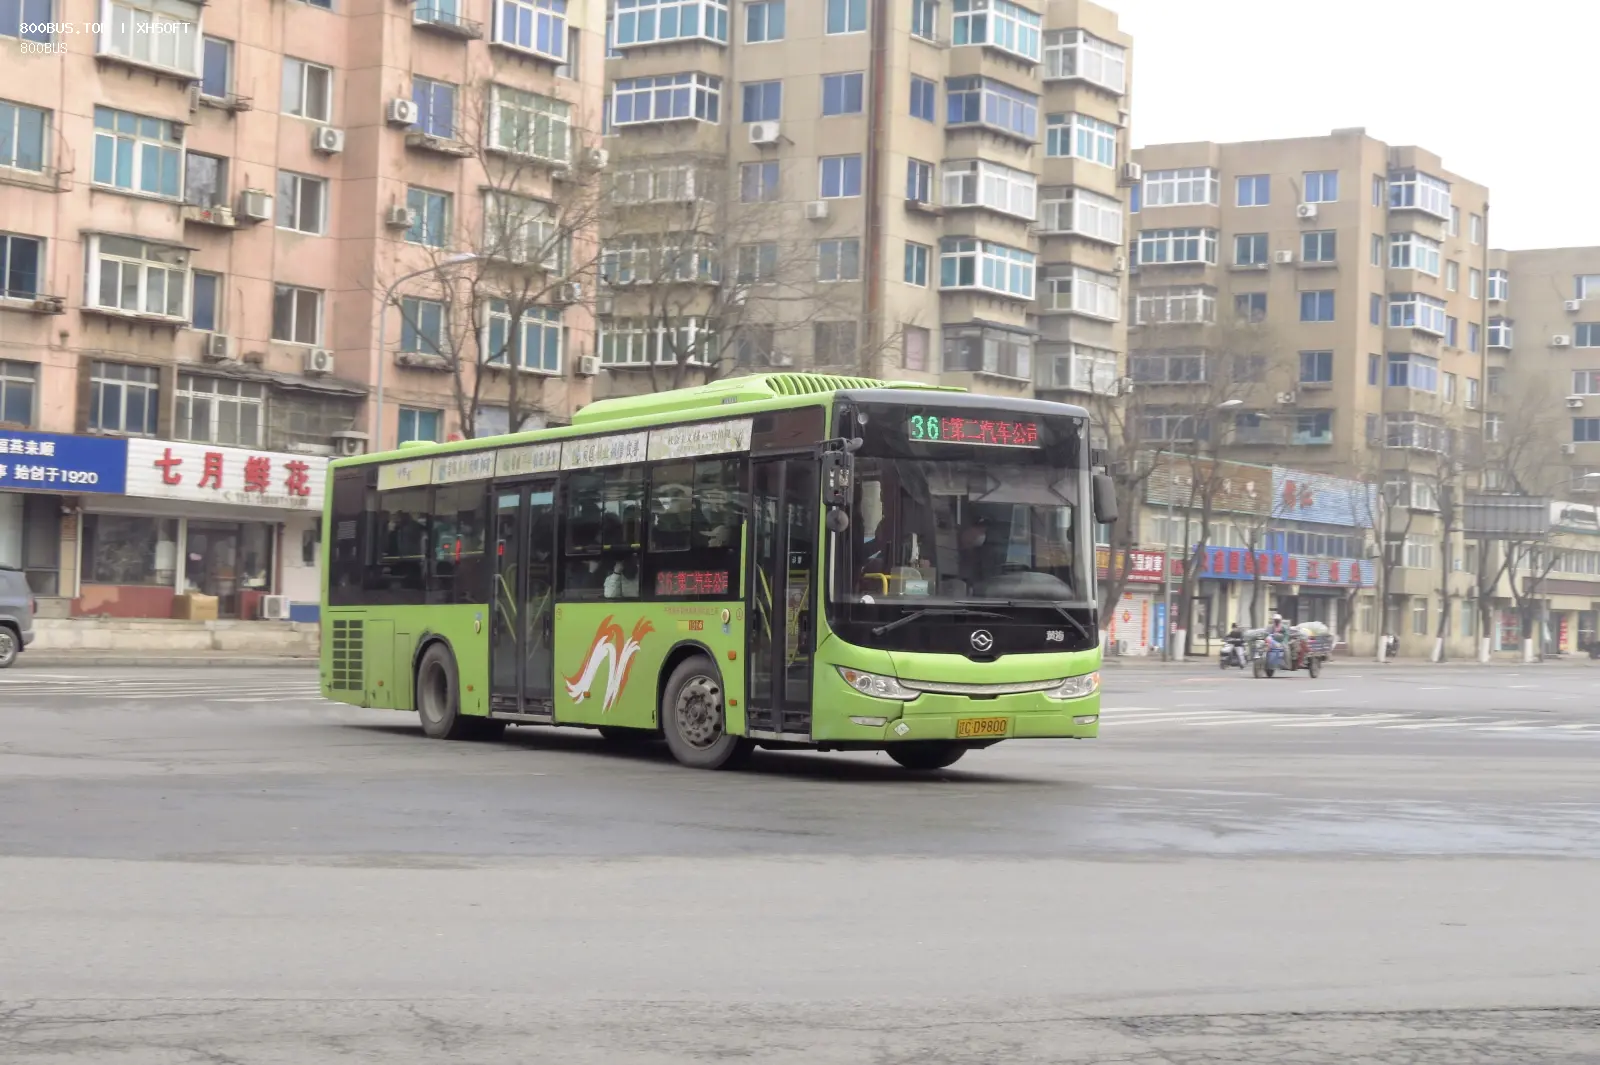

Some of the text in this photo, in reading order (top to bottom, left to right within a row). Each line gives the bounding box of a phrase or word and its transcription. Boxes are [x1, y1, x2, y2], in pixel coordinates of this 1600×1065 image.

[911, 415, 939, 440] 36
[14, 464, 99, 484] 始创于1920
[154, 447, 311, 497] 七月鲜花
